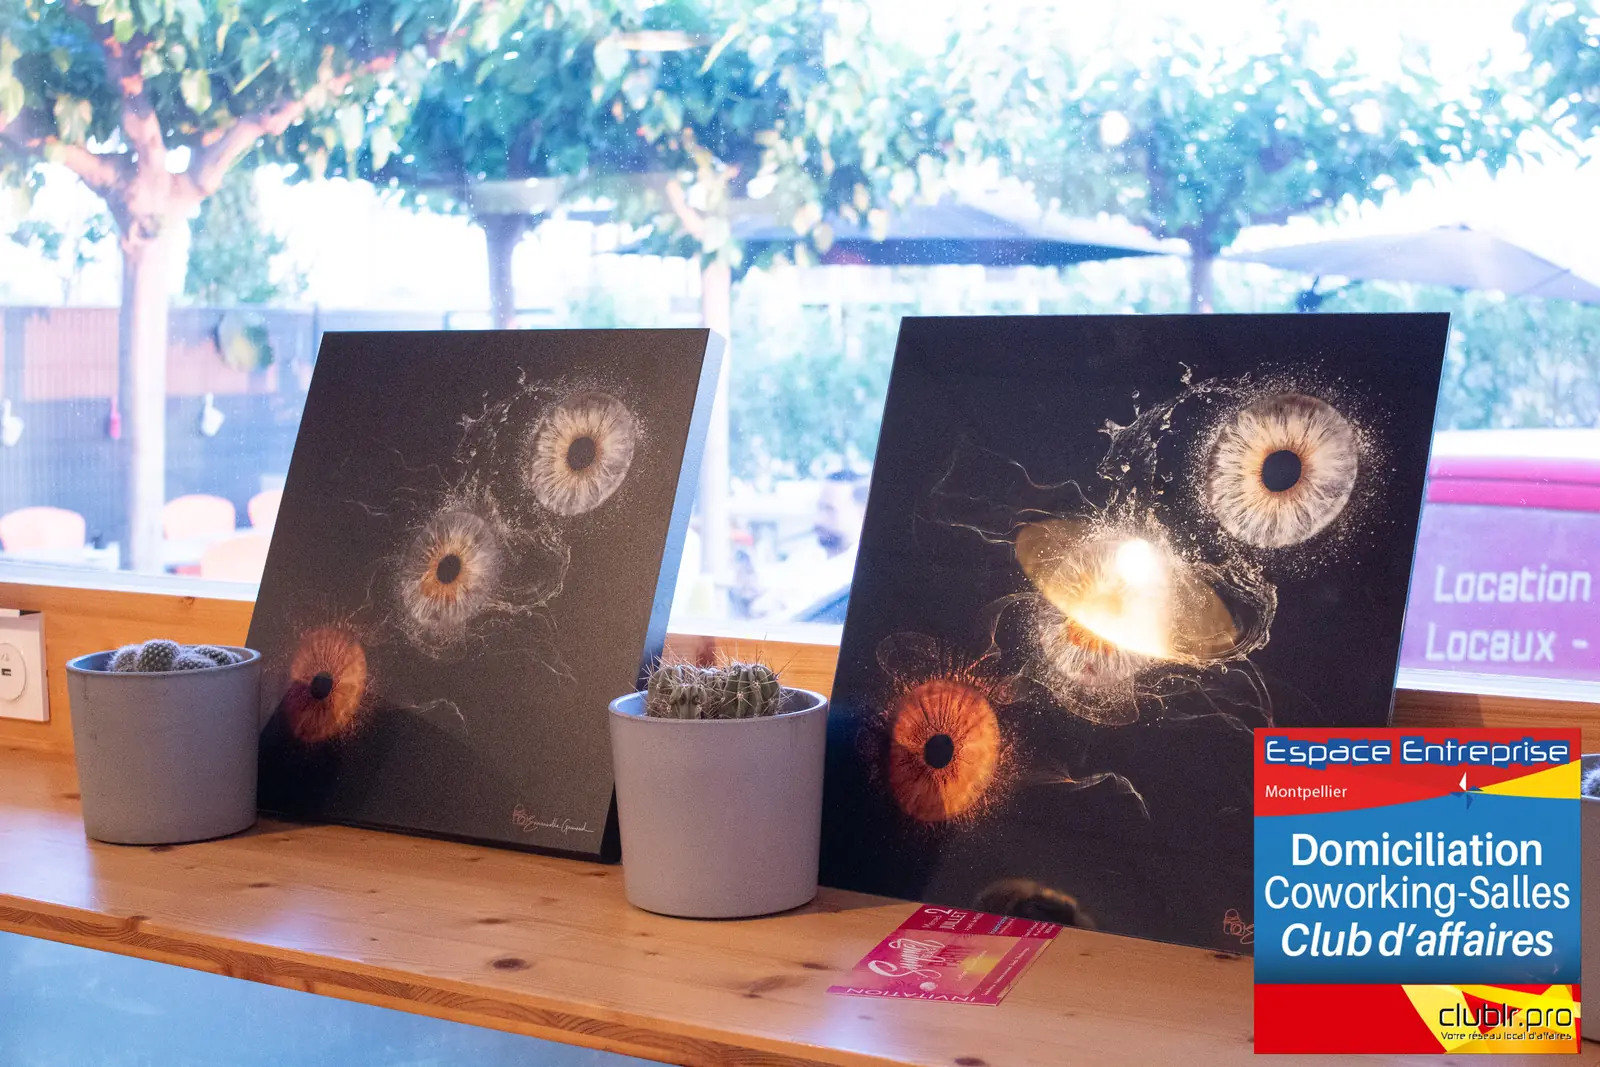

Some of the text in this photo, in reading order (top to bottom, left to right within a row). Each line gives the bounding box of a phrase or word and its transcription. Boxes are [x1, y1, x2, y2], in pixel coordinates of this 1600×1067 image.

[1434, 564, 1592, 604] Location
[1425, 621, 1557, 663] Locaux
[846, 987, 976, 1003] INVITATION
